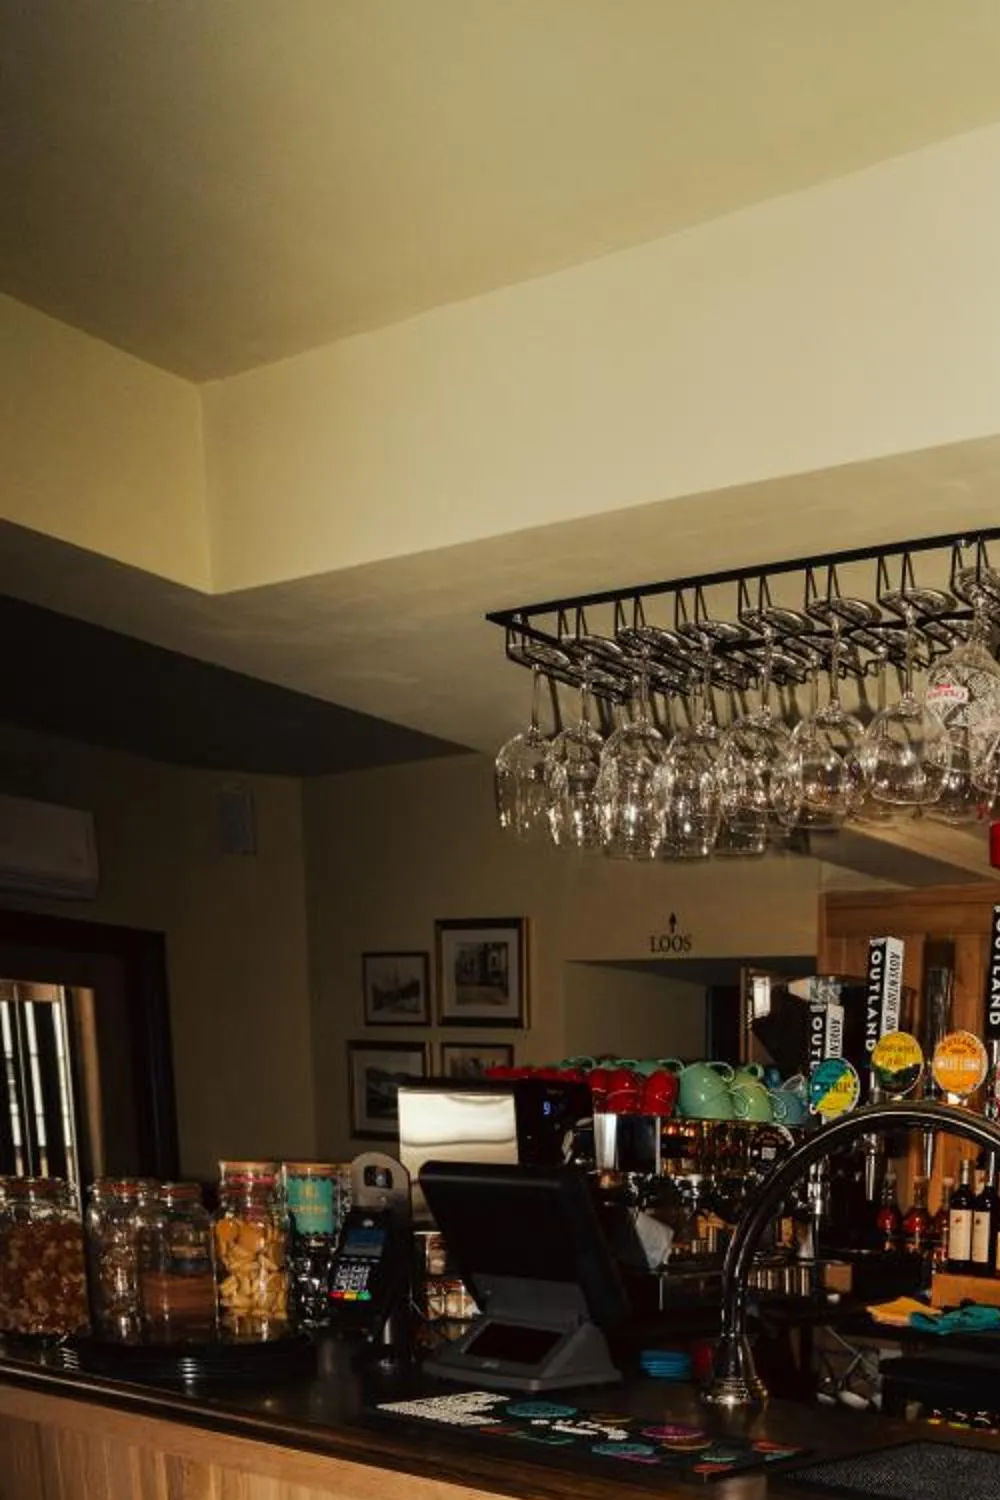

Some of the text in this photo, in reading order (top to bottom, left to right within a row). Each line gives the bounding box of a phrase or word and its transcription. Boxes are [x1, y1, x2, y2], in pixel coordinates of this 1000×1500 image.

[650, 935, 692, 953] LOOS
[866, 952, 884, 1052] OUTLAND
[808, 1016, 823, 1074] OUTL
[829, 1017, 841, 1058] ADVEN
